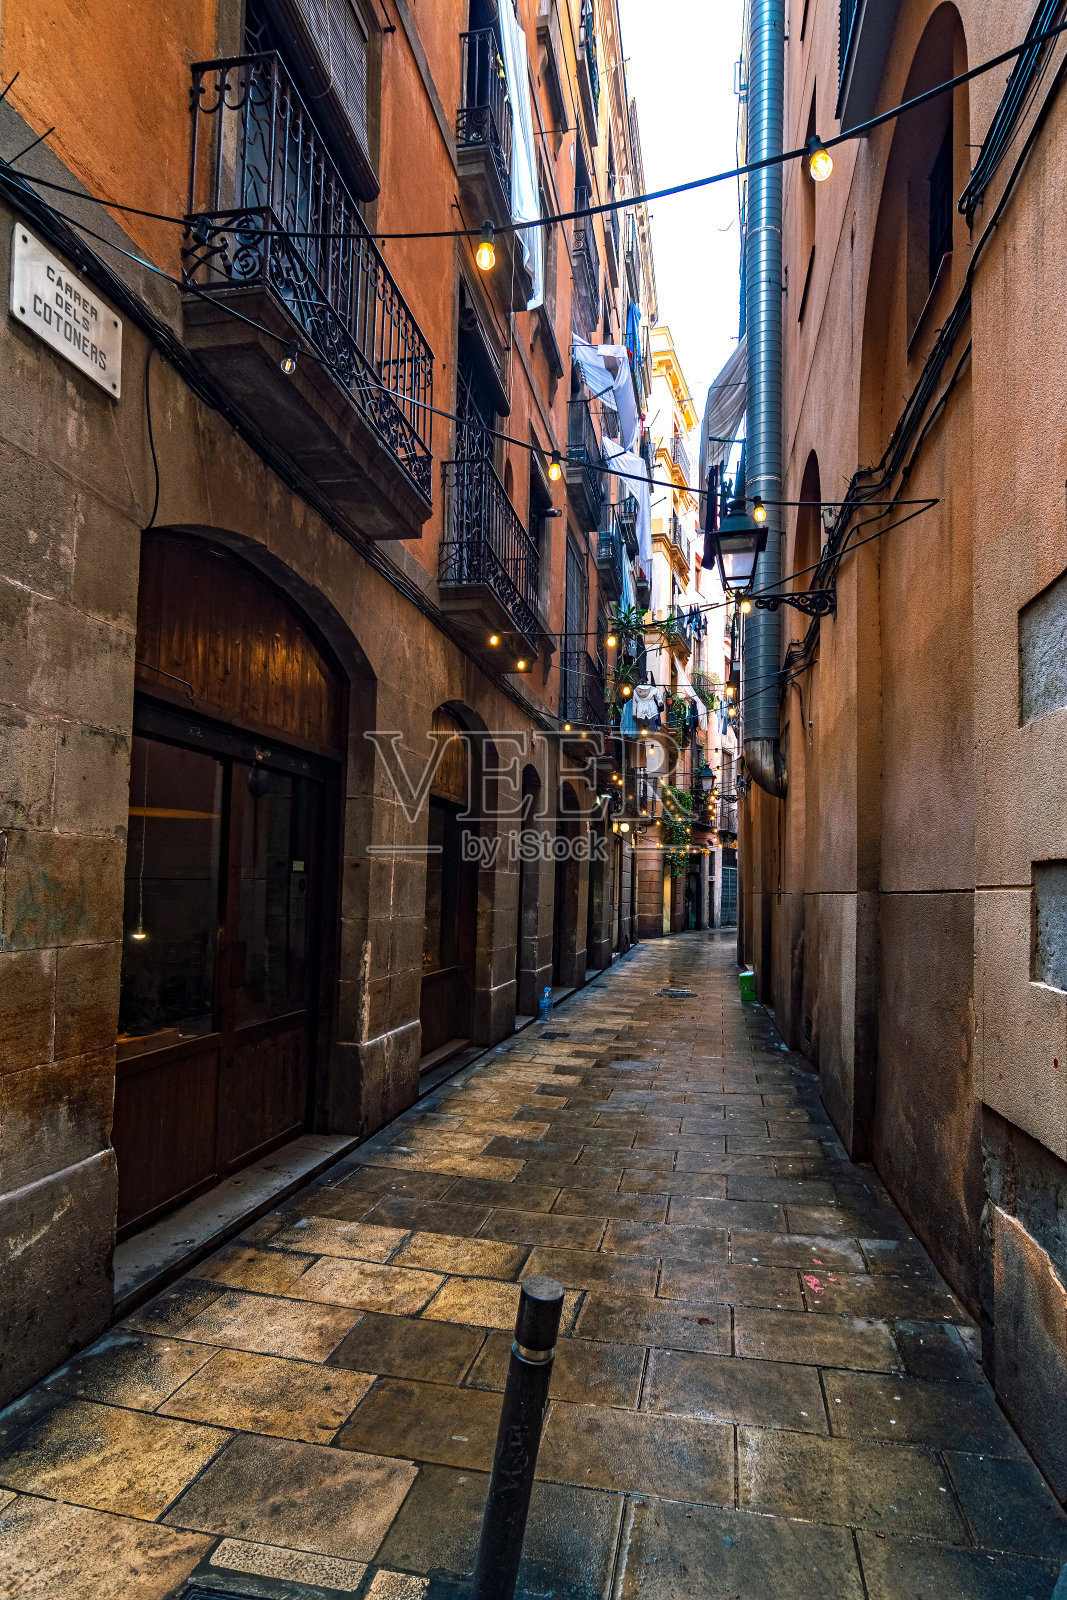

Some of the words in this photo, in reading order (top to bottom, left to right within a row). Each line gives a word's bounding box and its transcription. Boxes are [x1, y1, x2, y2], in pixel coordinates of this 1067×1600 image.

[46, 265, 98, 321] CARRER
[55, 291, 90, 332] DELS
[33, 293, 107, 371] COTONERS
